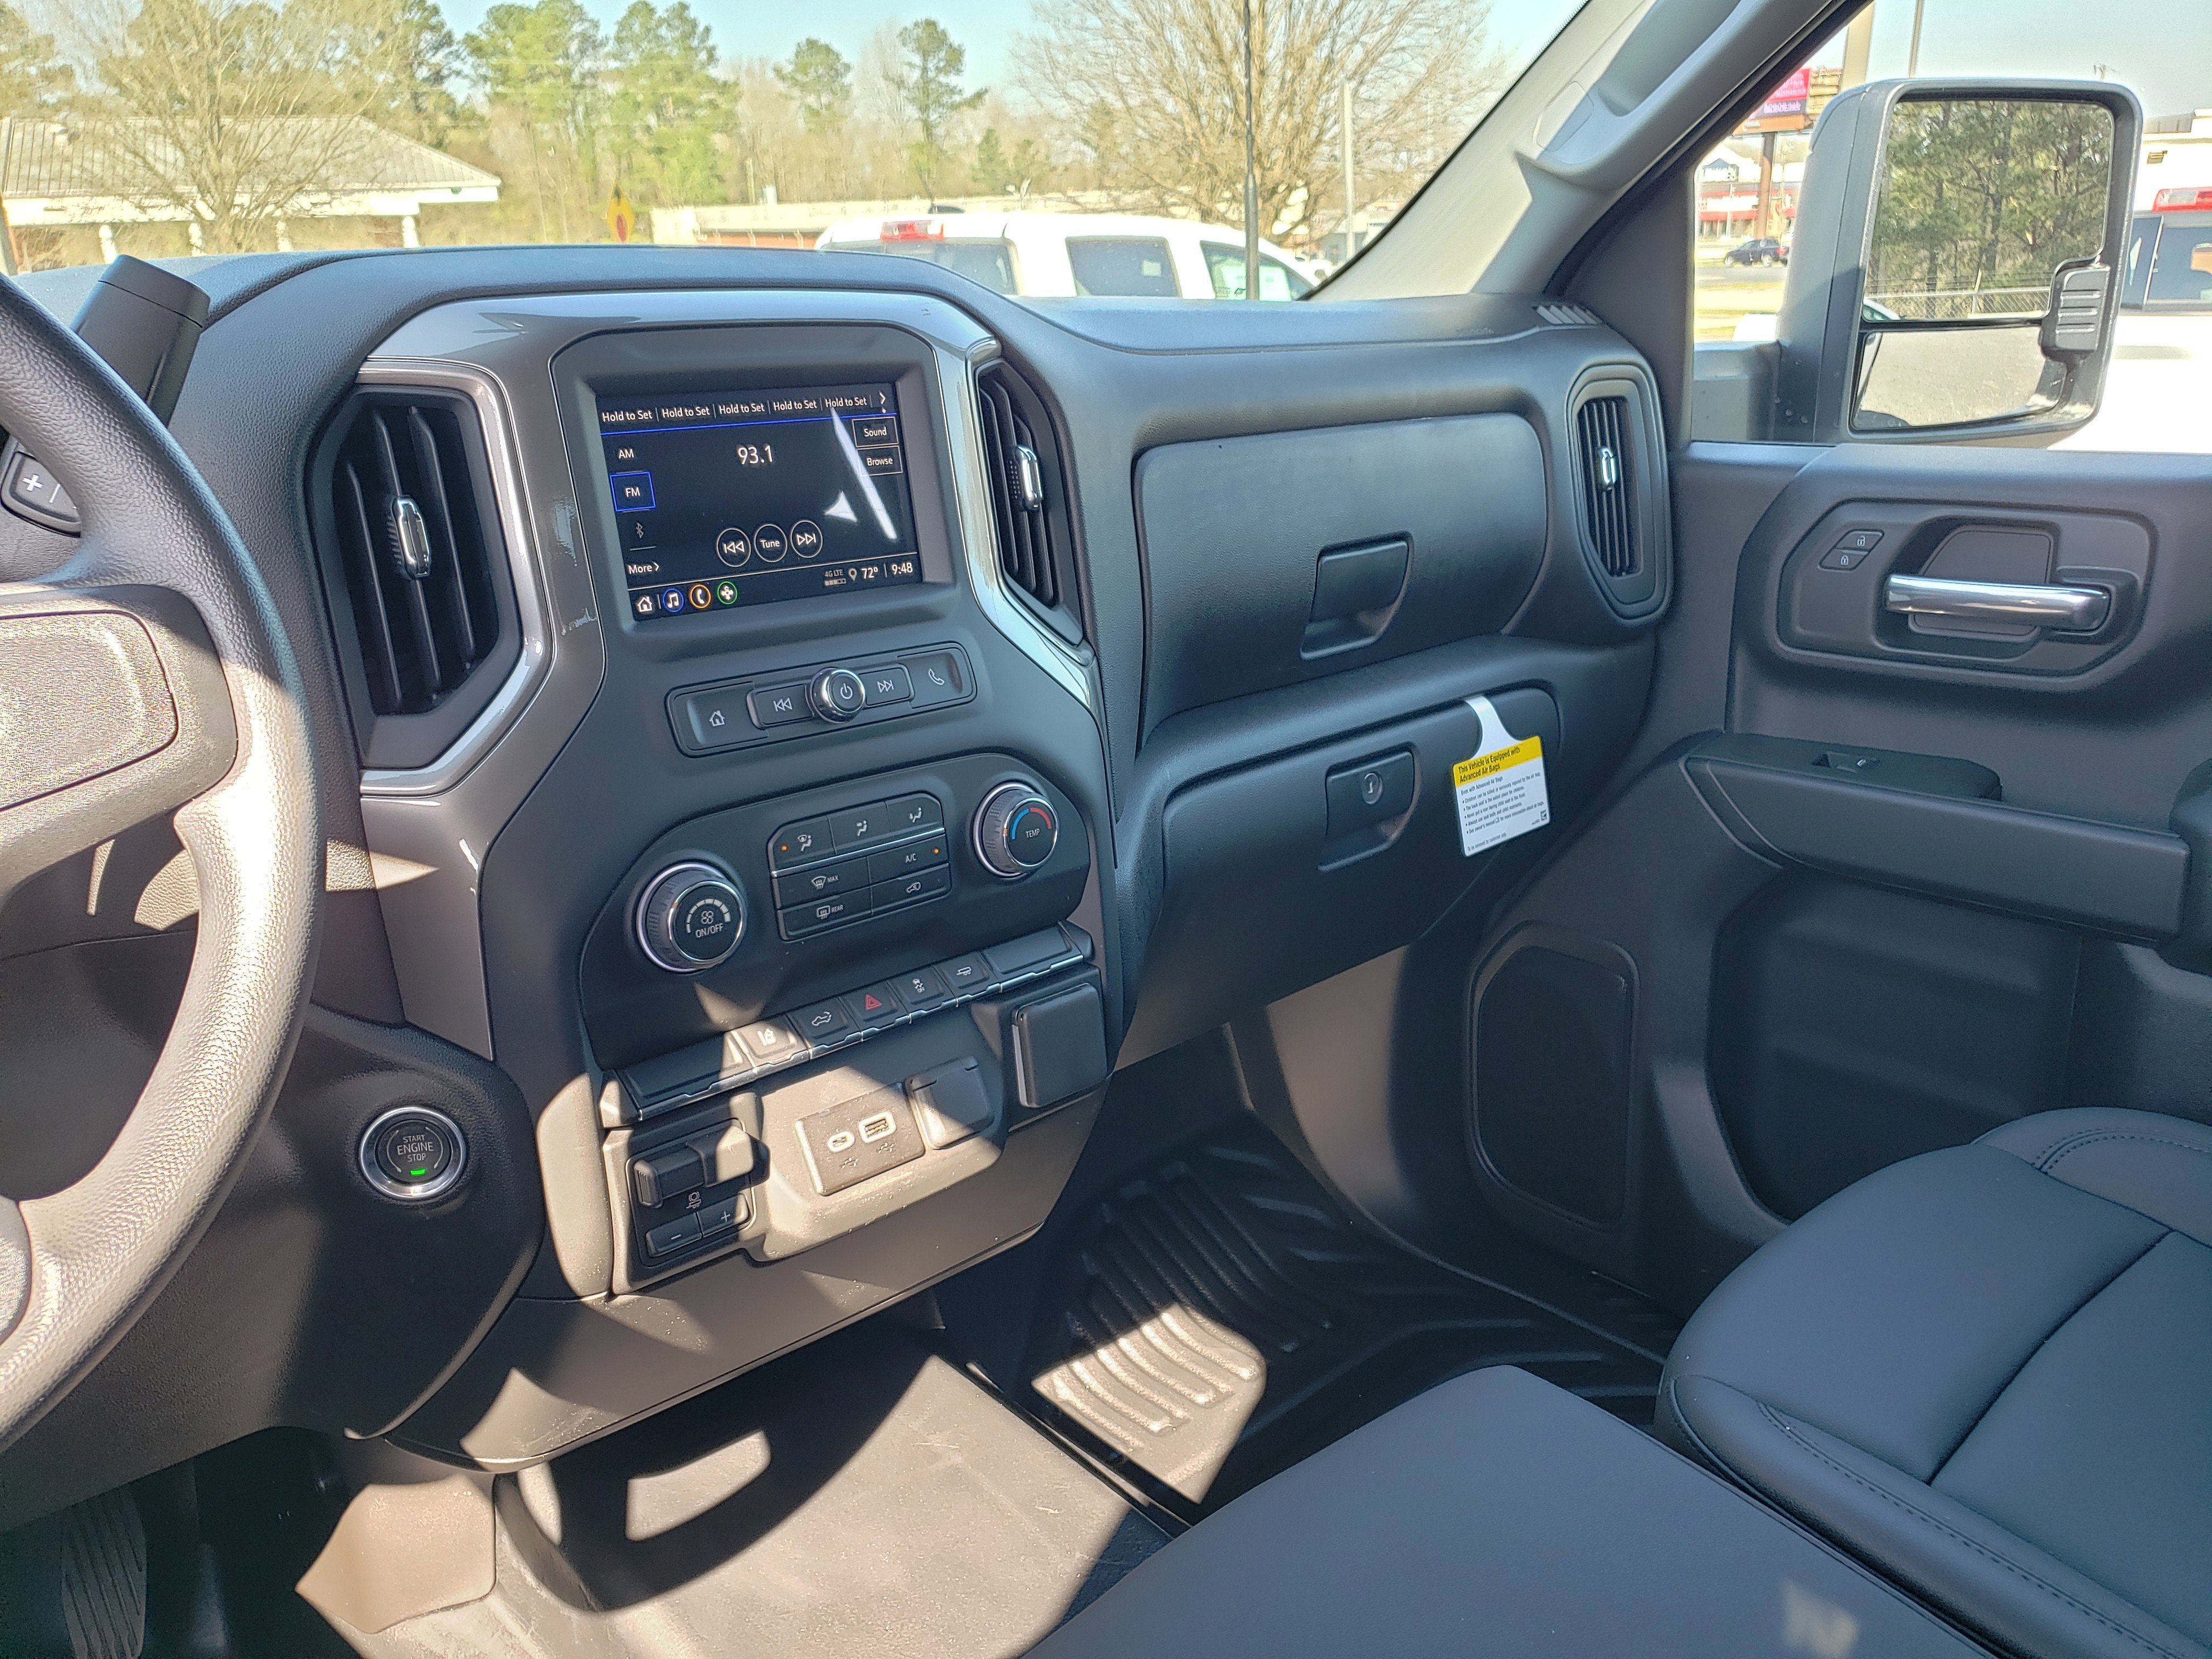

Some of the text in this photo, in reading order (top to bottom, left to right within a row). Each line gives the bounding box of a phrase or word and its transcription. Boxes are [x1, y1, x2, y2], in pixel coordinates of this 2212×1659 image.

[774, 400, 817, 411] Hold to Set
[826, 397, 867, 408] Hold to Set
[662, 407, 710, 418] Hold to Set
[719, 403, 765, 415] Hold to Set
[602, 410, 653, 422] Hold to Set
[864, 427, 887, 437] Sound
[618, 449, 634, 459] AM
[738, 445, 772, 465] 93.1
[867, 457, 894, 466] Browse
[625, 487, 640, 498] FM
[760, 540, 780, 549] Tune
[628, 565, 652, 574] More
[891, 562, 913, 575] 9:48
[1459, 765, 1468, 774] This
[1468, 759, 1485, 770] Vehicle
[1490, 749, 1510, 763] Equipped
[1511, 746, 1520, 755] with
[1460, 769, 1481, 783] Advanced
[1489, 763, 1500, 772] Bags
[1025, 828, 1040, 838] TEMP
[906, 853, 916, 863] A/C
[831, 905, 844, 913] REAR
[696, 923, 724, 938] ON/OFF
[397, 1142, 433, 1155] ENGINE
[408, 1153, 426, 1162] STOP
